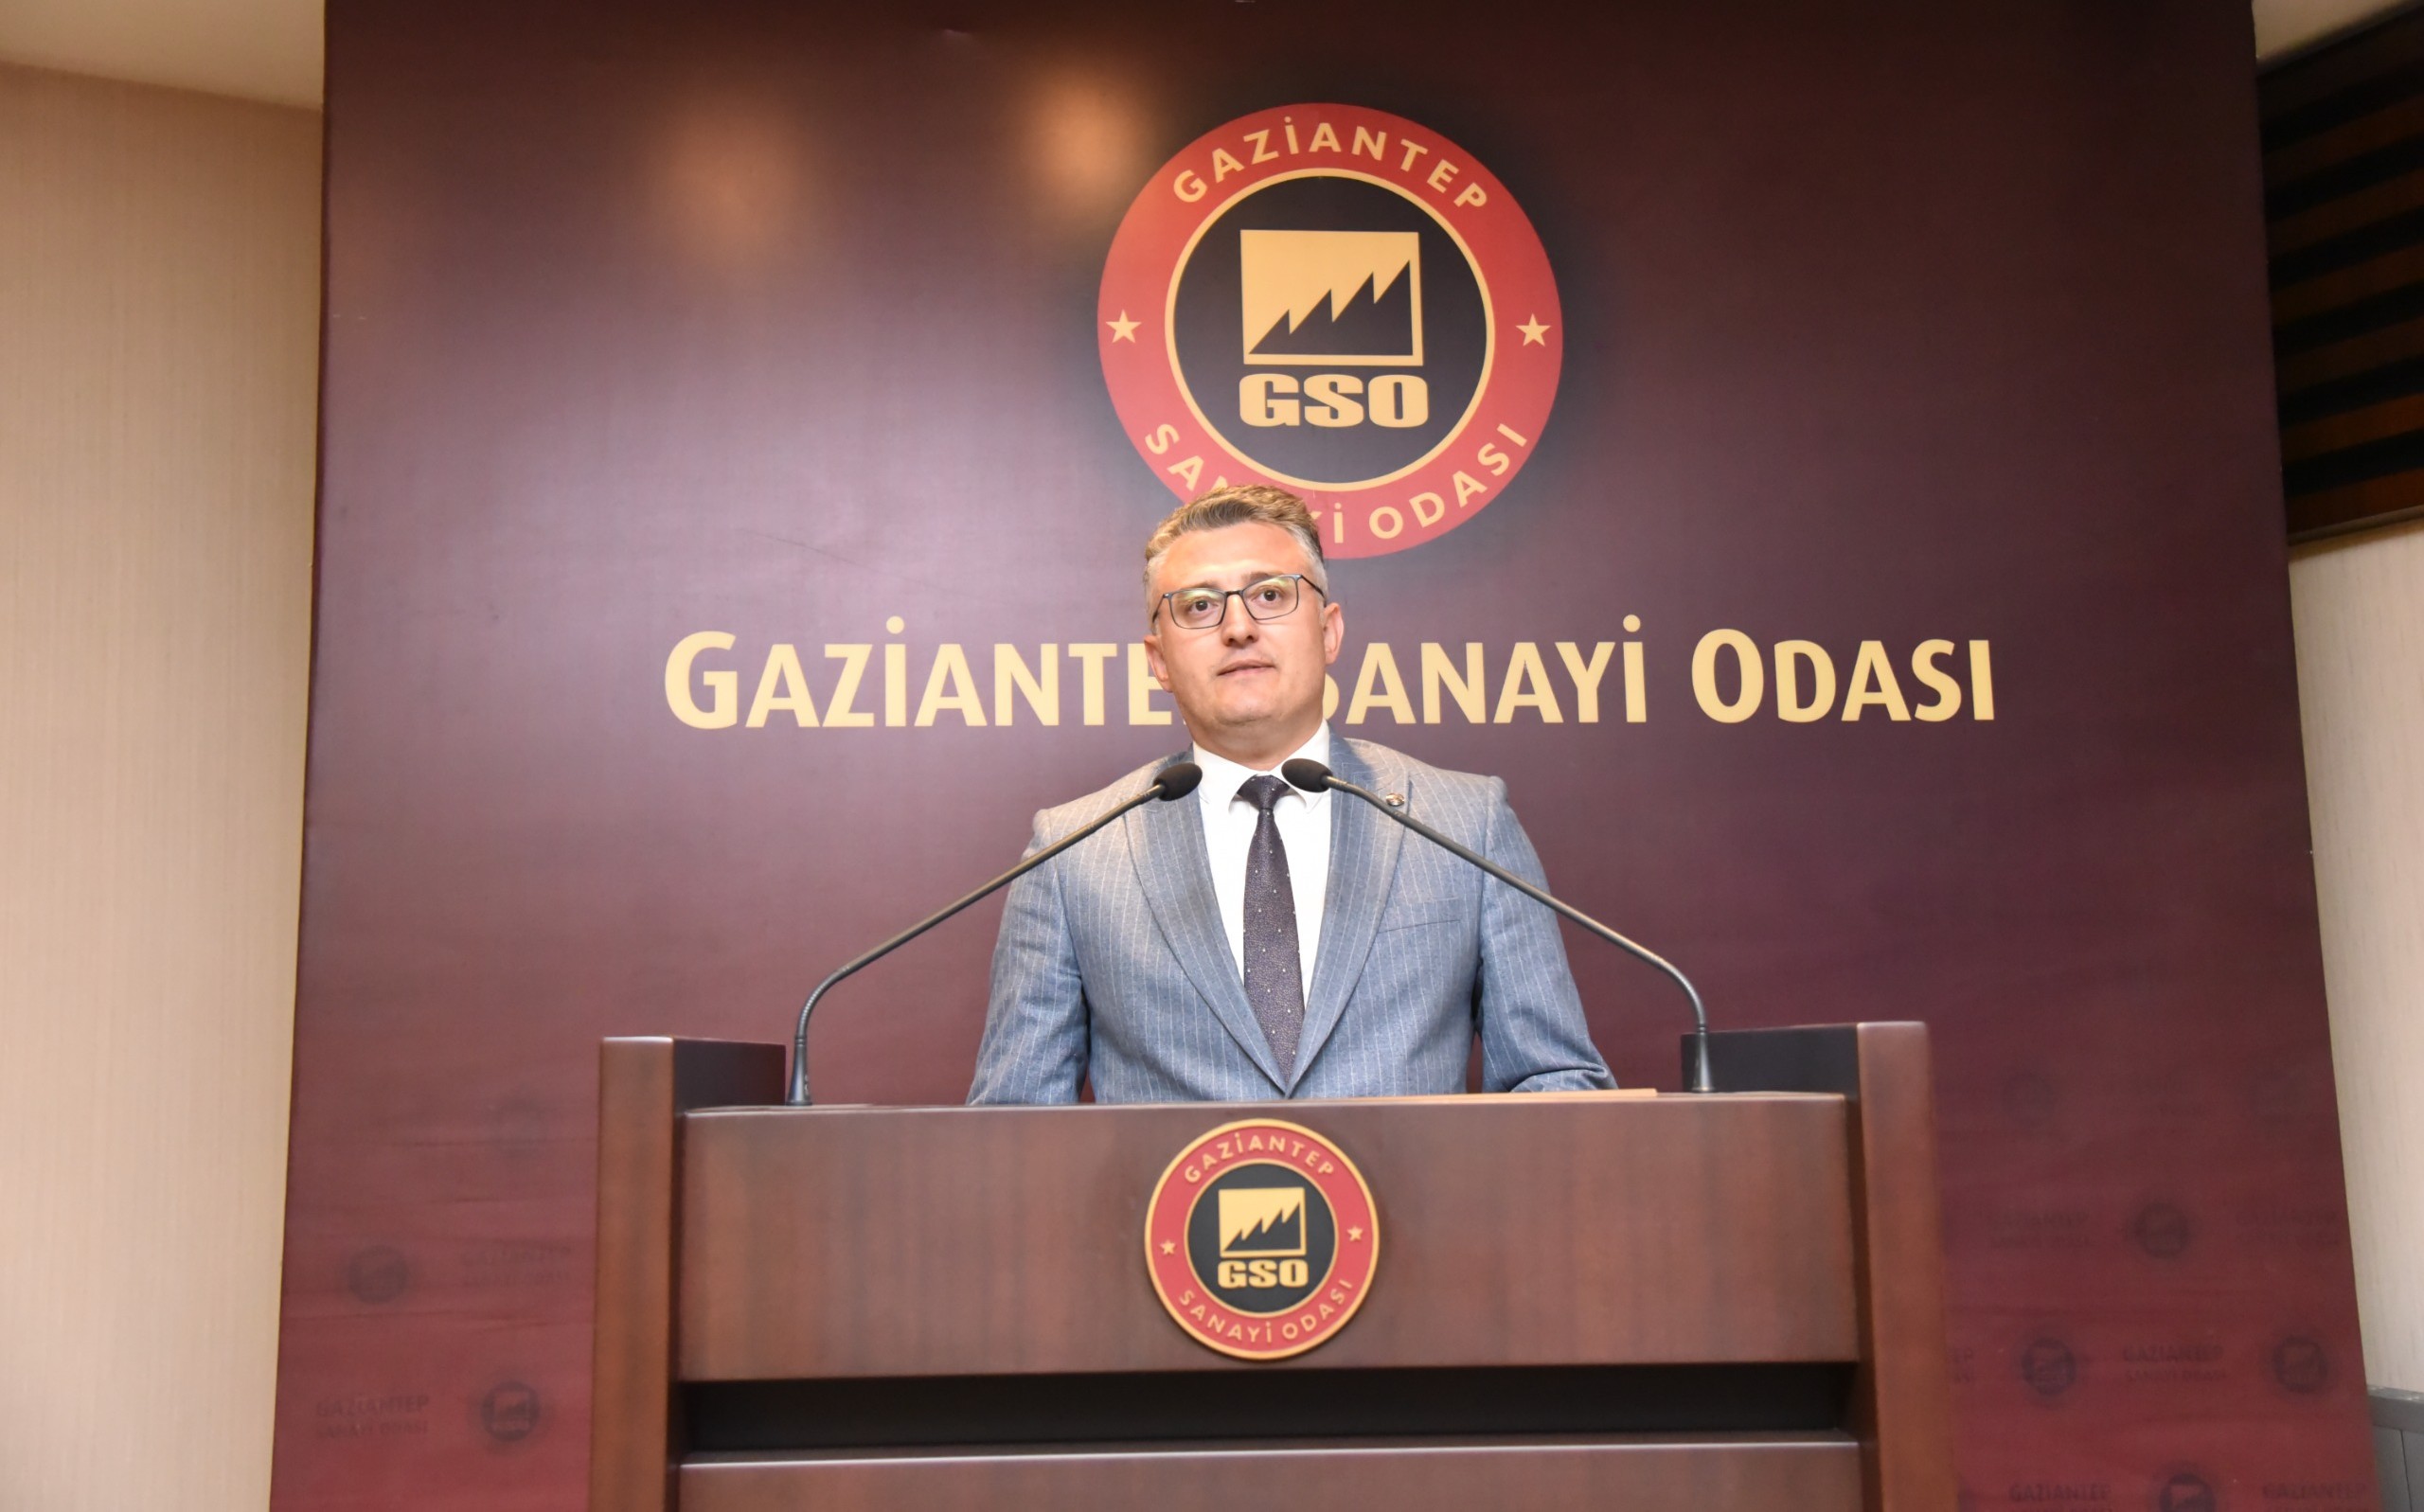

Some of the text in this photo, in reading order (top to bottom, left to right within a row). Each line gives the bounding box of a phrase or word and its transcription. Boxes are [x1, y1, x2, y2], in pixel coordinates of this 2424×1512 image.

[1172, 116, 1488, 210] GAZİANTEP
[1239, 373, 1429, 428] GSO
[1145, 423, 1527, 543] SAİ ODASI
[664, 616, 1186, 729] GAZİANTE
[1691, 628, 1995, 723] ODASI
[1184, 1132, 1334, 1183] GAZİANTEP
[1218, 1259, 1309, 1289] GSO
[1179, 1279, 1352, 1343] SANAYİ ODASI
